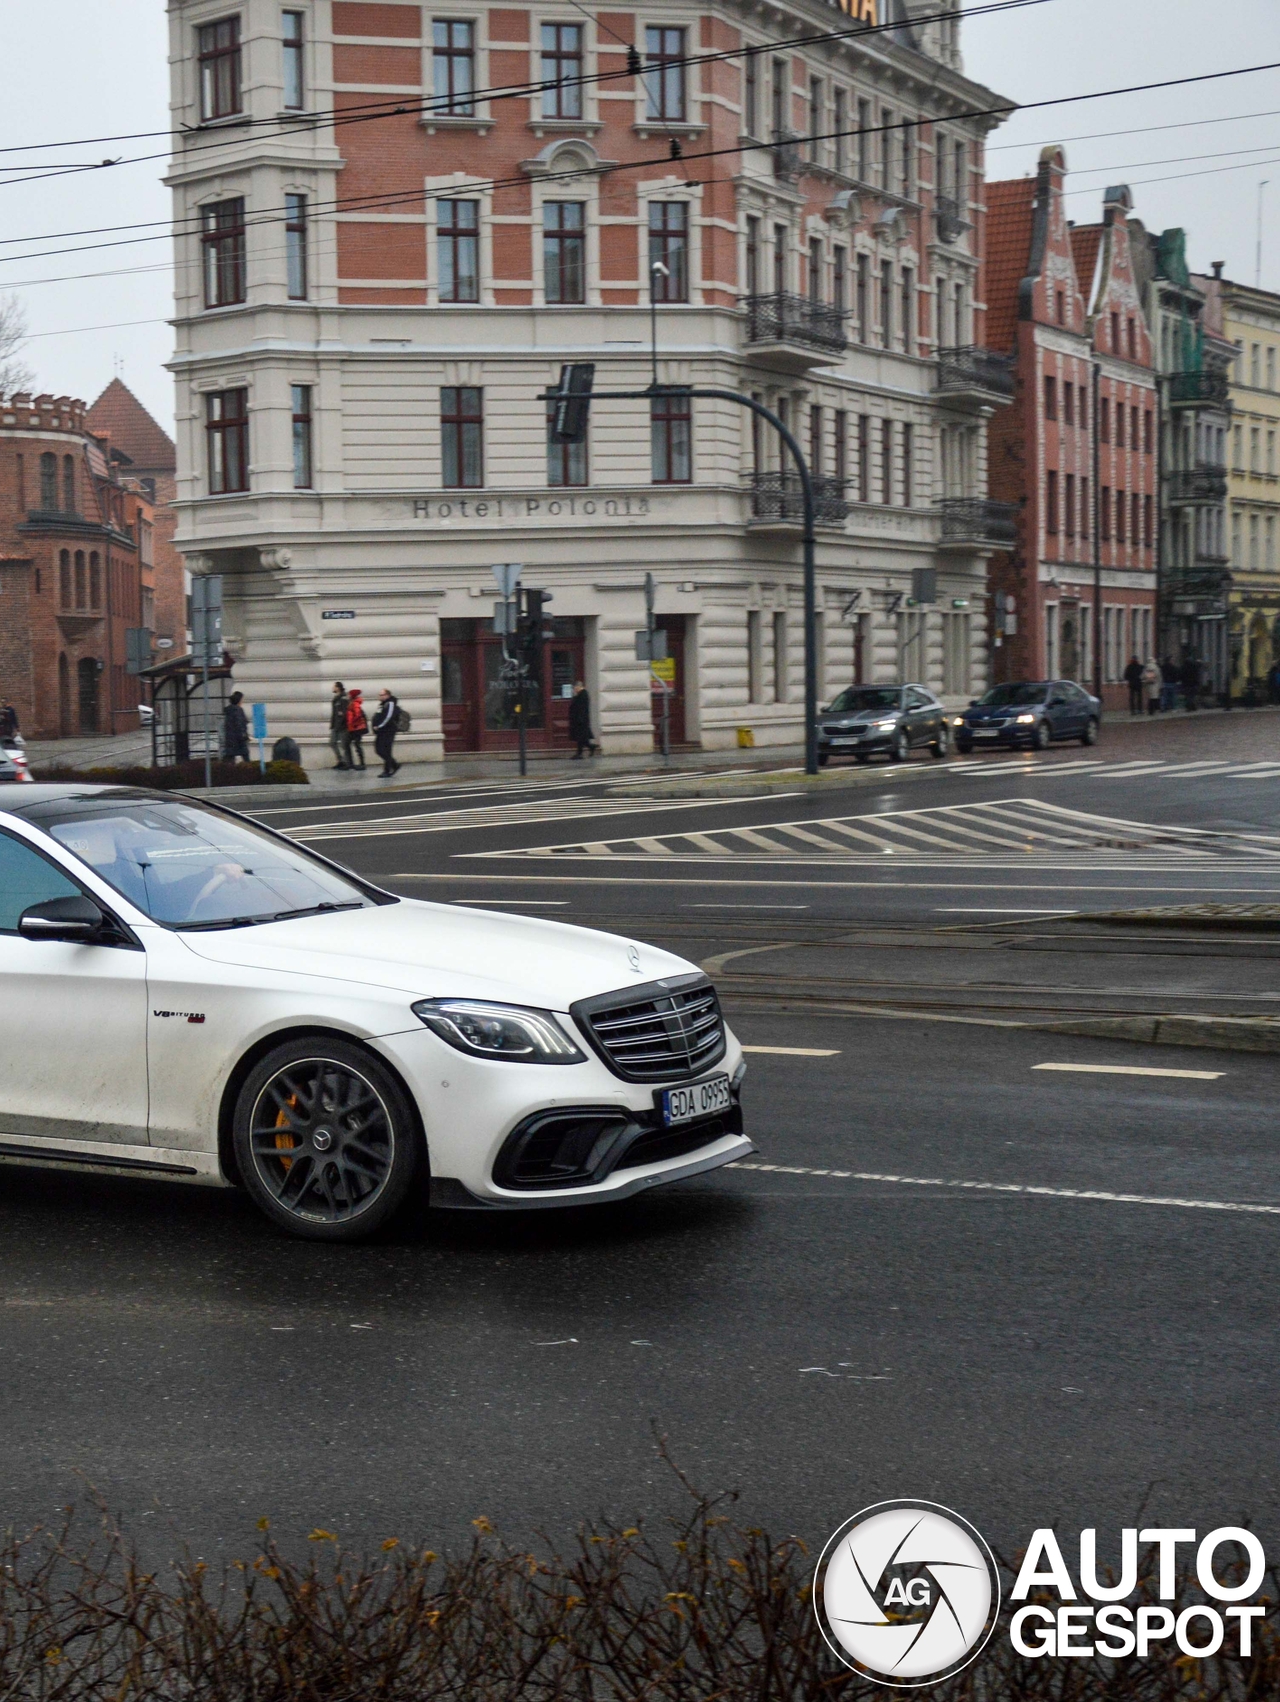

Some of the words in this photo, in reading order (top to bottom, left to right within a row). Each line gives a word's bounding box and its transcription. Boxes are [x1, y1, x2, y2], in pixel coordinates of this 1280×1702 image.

[412, 499, 503, 519] Hotel
[525, 496, 651, 517] Polonia
[670, 1089, 696, 1118] GDA
[701, 1079, 728, 1110] 09955
